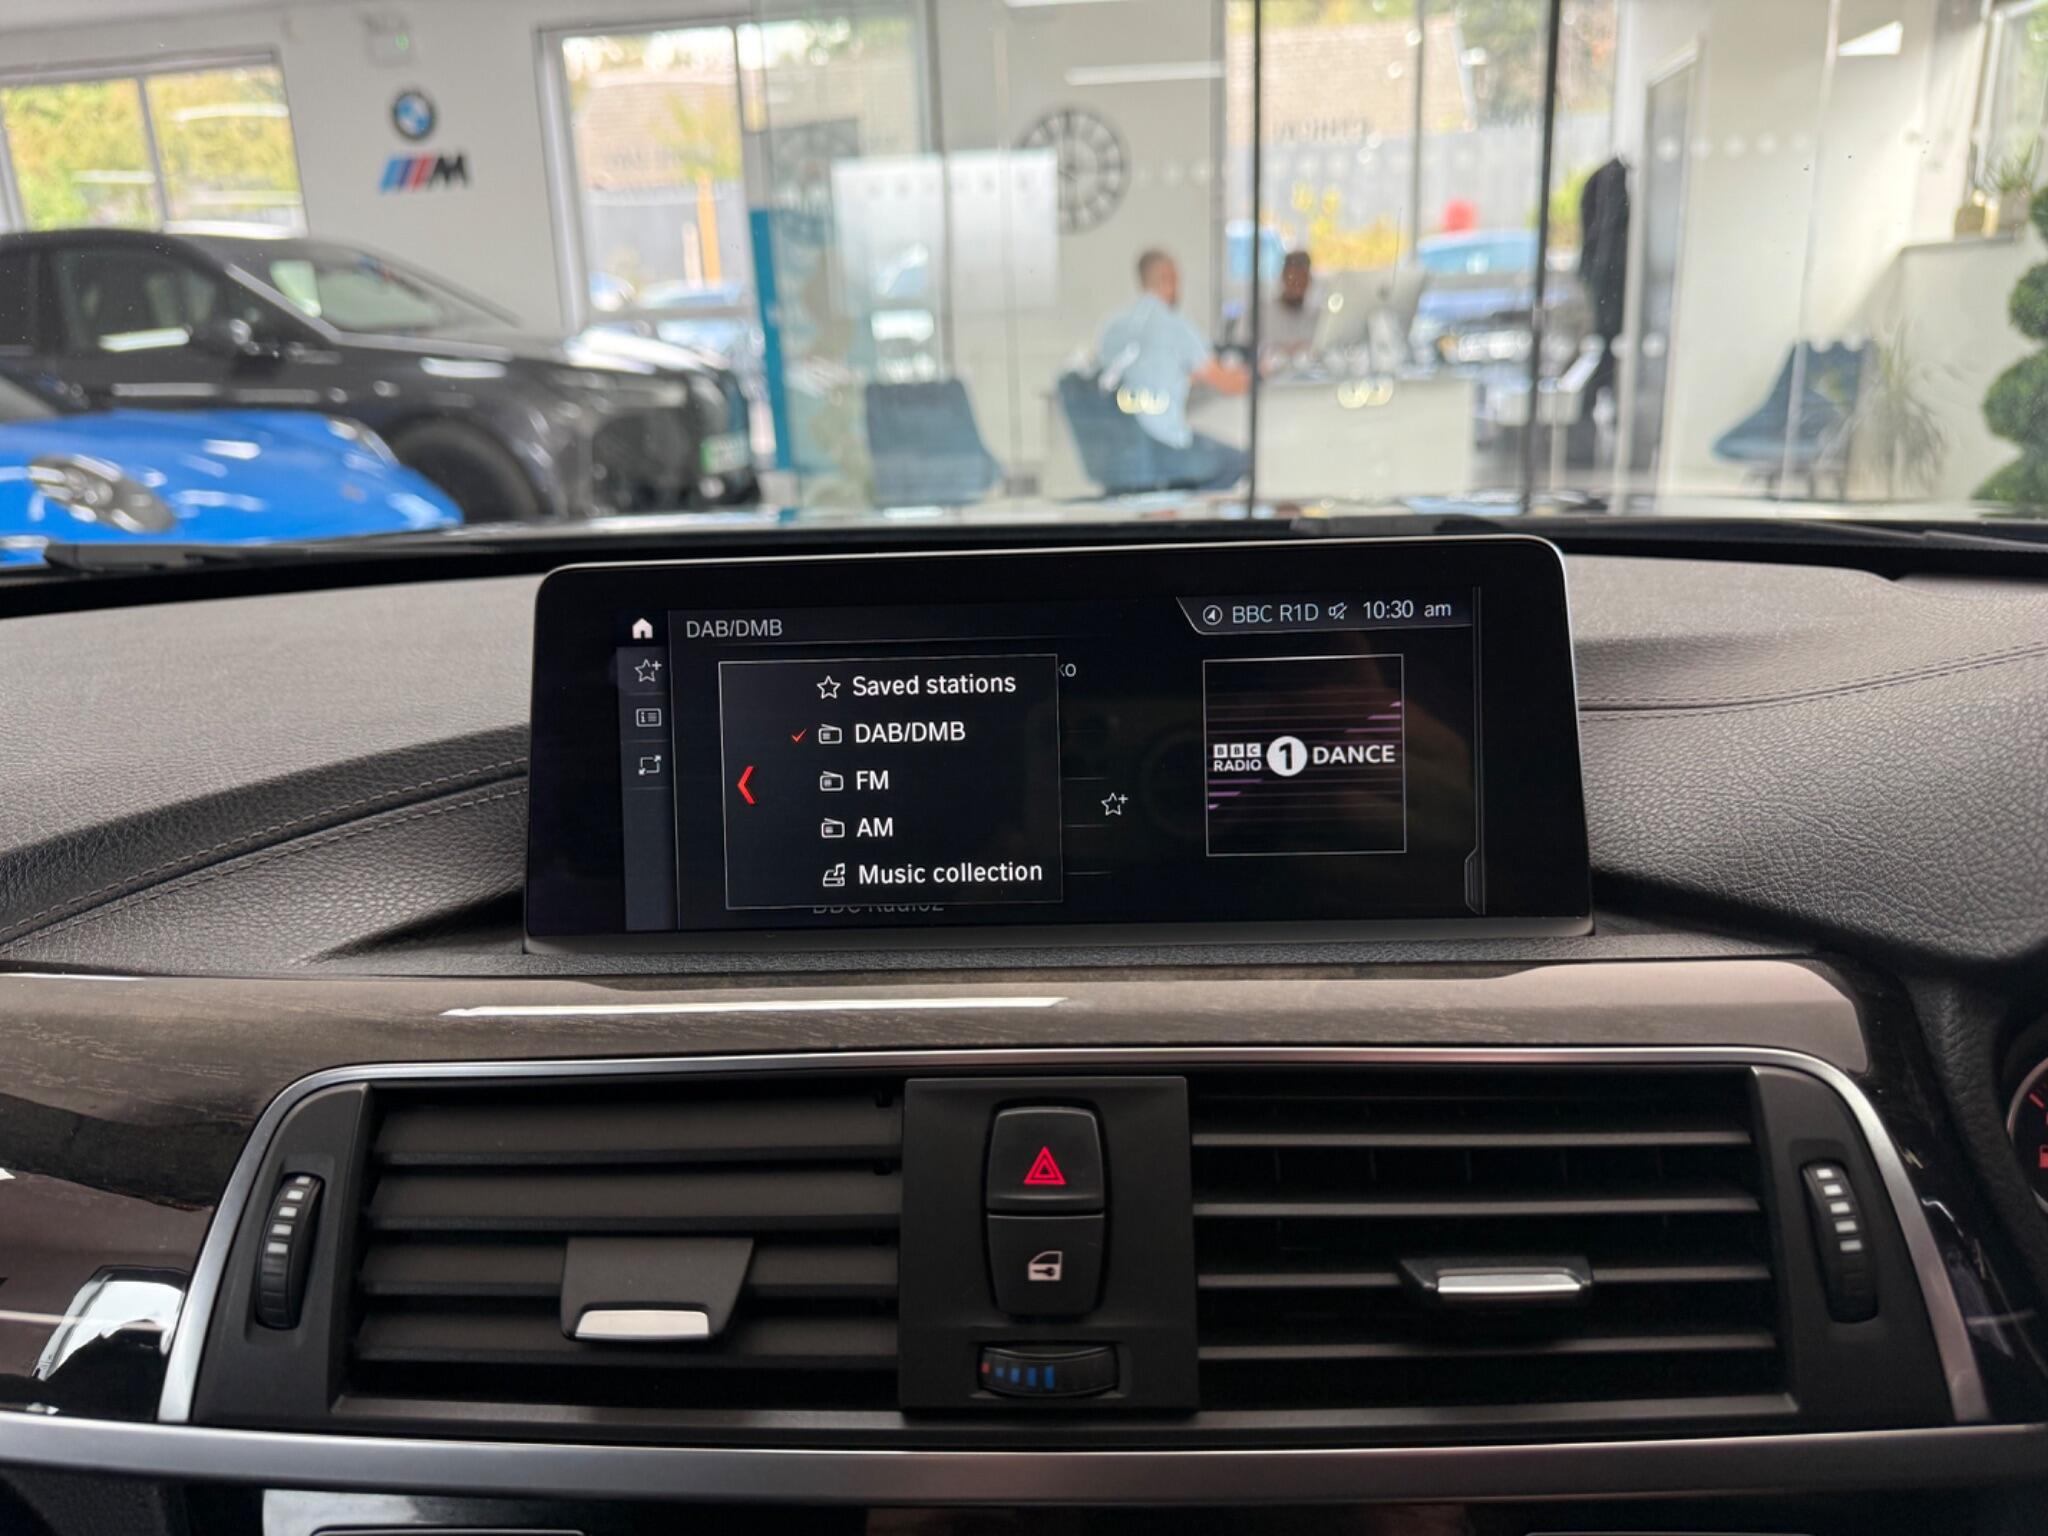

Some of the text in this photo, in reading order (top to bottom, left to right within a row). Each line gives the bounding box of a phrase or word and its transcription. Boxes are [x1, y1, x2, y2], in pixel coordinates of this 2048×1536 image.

[1232, 604, 1319, 624] BBC R1D
[1363, 600, 1451, 620] 10:30 am
[686, 618, 783, 638] DAB/DMB
[853, 674, 1017, 697] Saved stations
[855, 721, 966, 743] DAB/DMB
[1213, 743, 1262, 759] BBC
[1213, 759, 1262, 772] RADIO
[1313, 745, 1396, 765] DANCE
[856, 771, 889, 790] FM
[857, 818, 893, 838] AM
[859, 862, 1043, 885] Music collection
